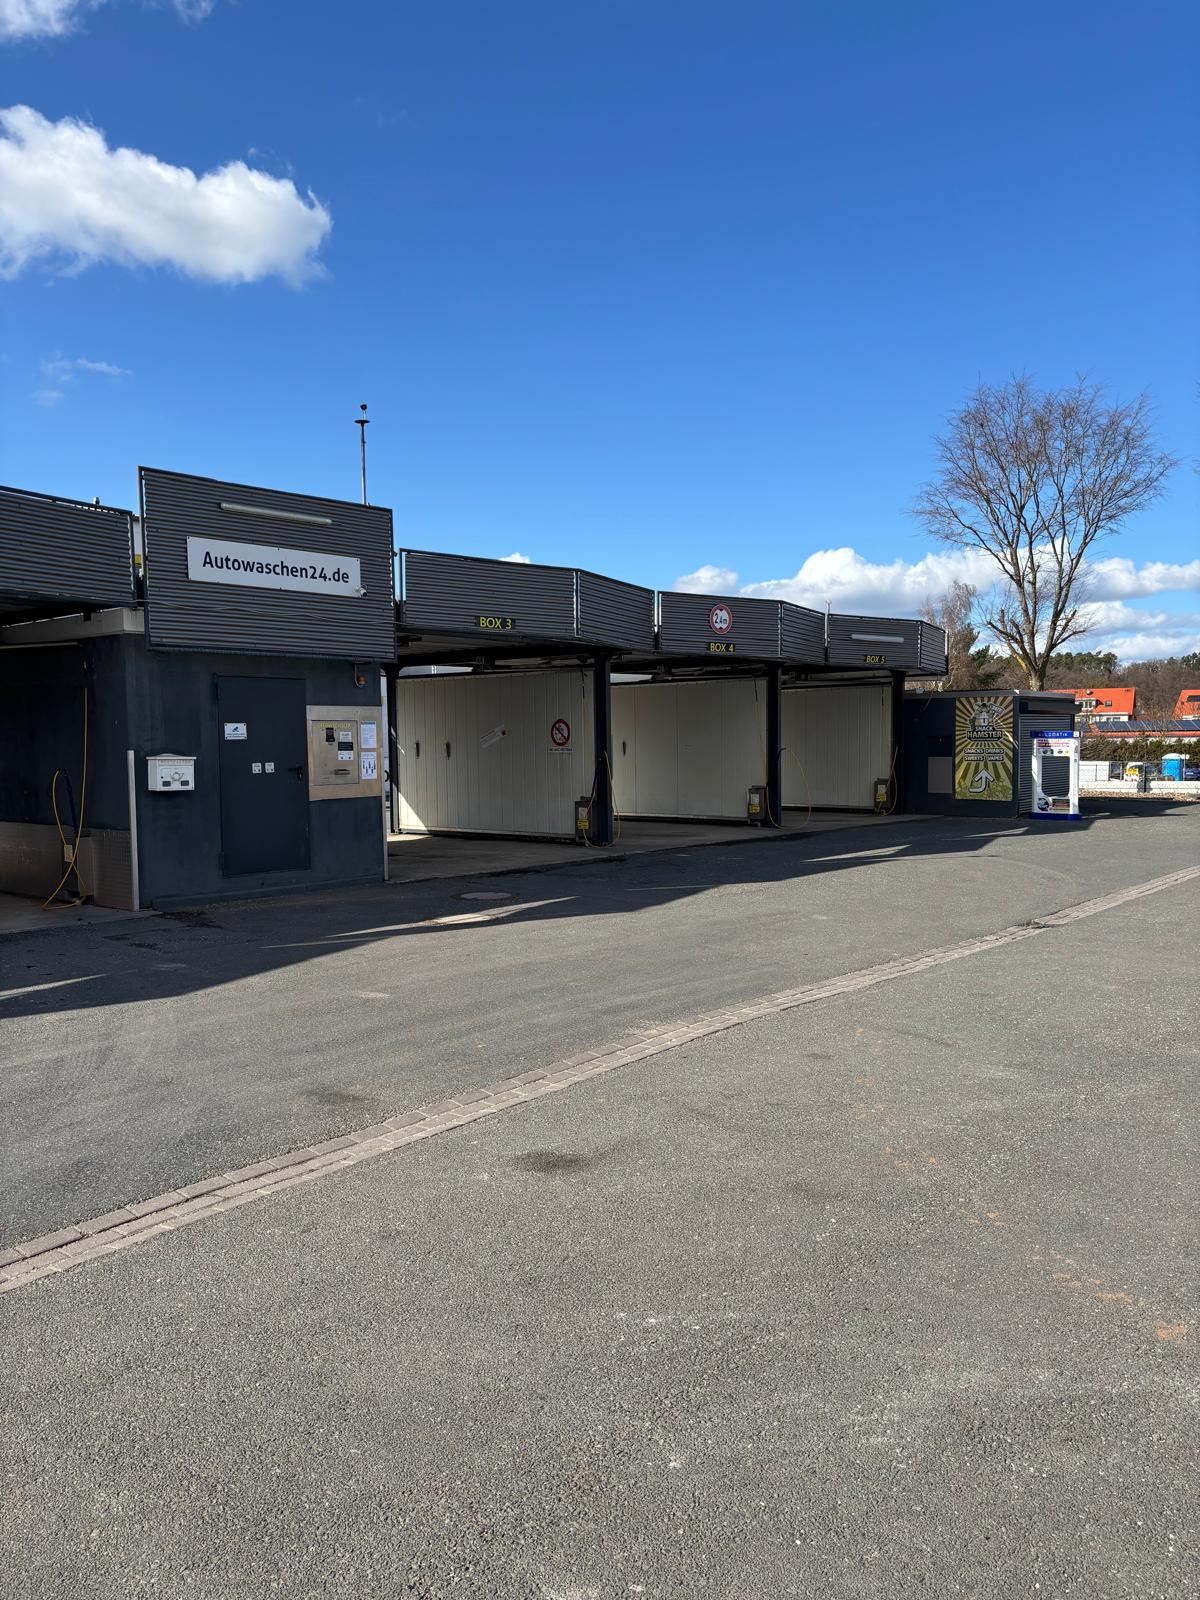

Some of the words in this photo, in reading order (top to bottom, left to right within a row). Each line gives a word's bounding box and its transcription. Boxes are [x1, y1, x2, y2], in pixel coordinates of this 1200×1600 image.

[202, 551, 350, 584] Autowaschen24.de
[480, 616, 502, 629] BOX
[505, 618, 512, 630] 3
[710, 643, 727, 652] BOX
[728, 643, 734, 652] 4
[866, 655, 879, 663] BOX
[880, 655, 885, 665] 5
